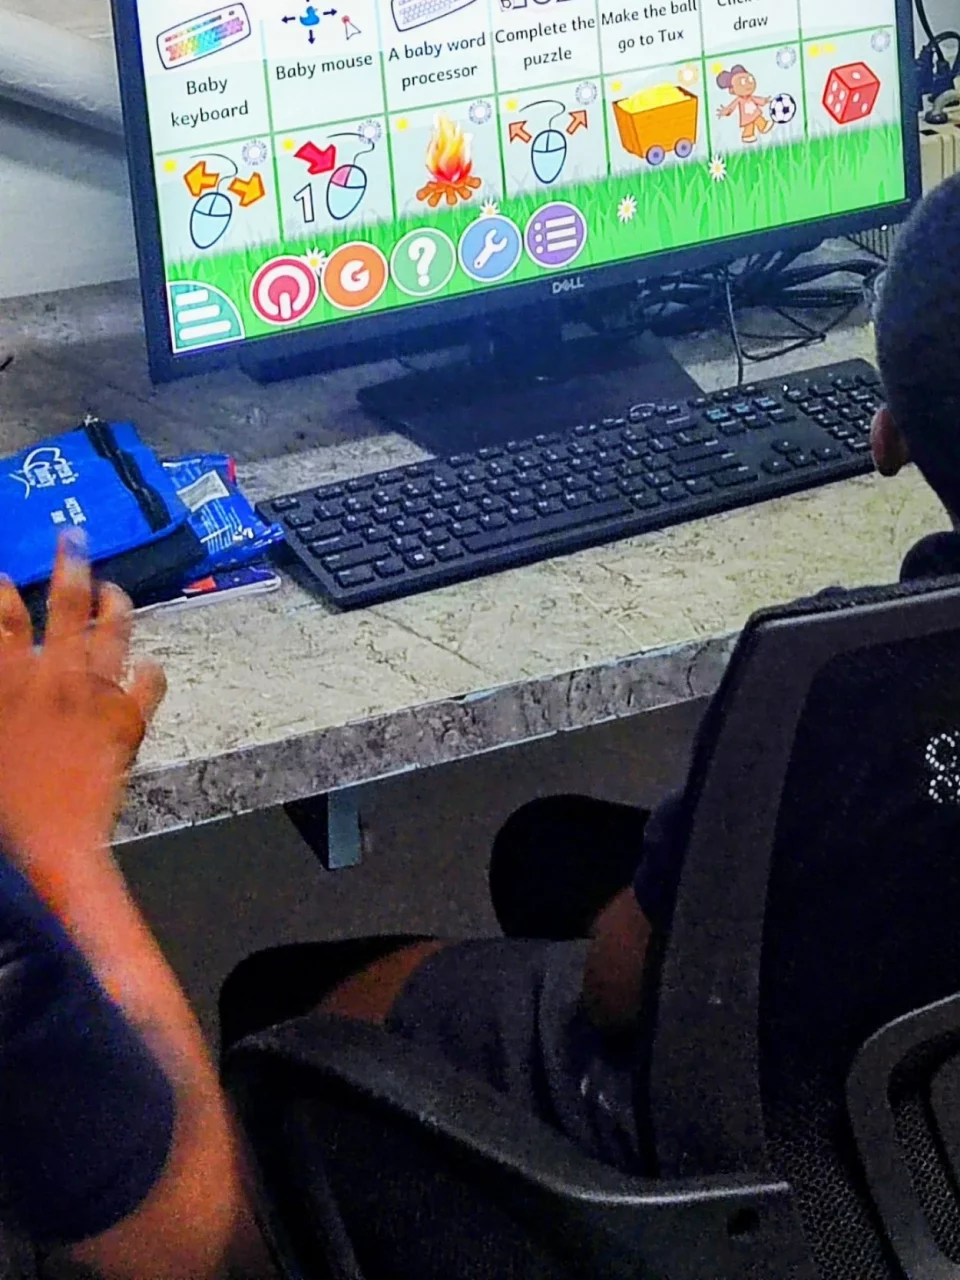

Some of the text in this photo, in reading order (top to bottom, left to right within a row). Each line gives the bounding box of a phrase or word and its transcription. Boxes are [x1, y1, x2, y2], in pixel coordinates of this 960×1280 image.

[601, 5, 640, 26] Make
[644, 1, 667, 19] the
[733, 14, 769, 32] draw
[495, 15, 596, 45] Complete the
[617, 27, 685, 53] go to Tux
[388, 31, 486, 62] A baby word
[523, 47, 573, 71] puzzle
[276, 54, 373, 81] Baby mouse
[401, 64, 478, 91] processor
[186, 75, 228, 96] Baby
[171, 100, 249, 128] keyboard
[552, 276, 585, 294] DELL
